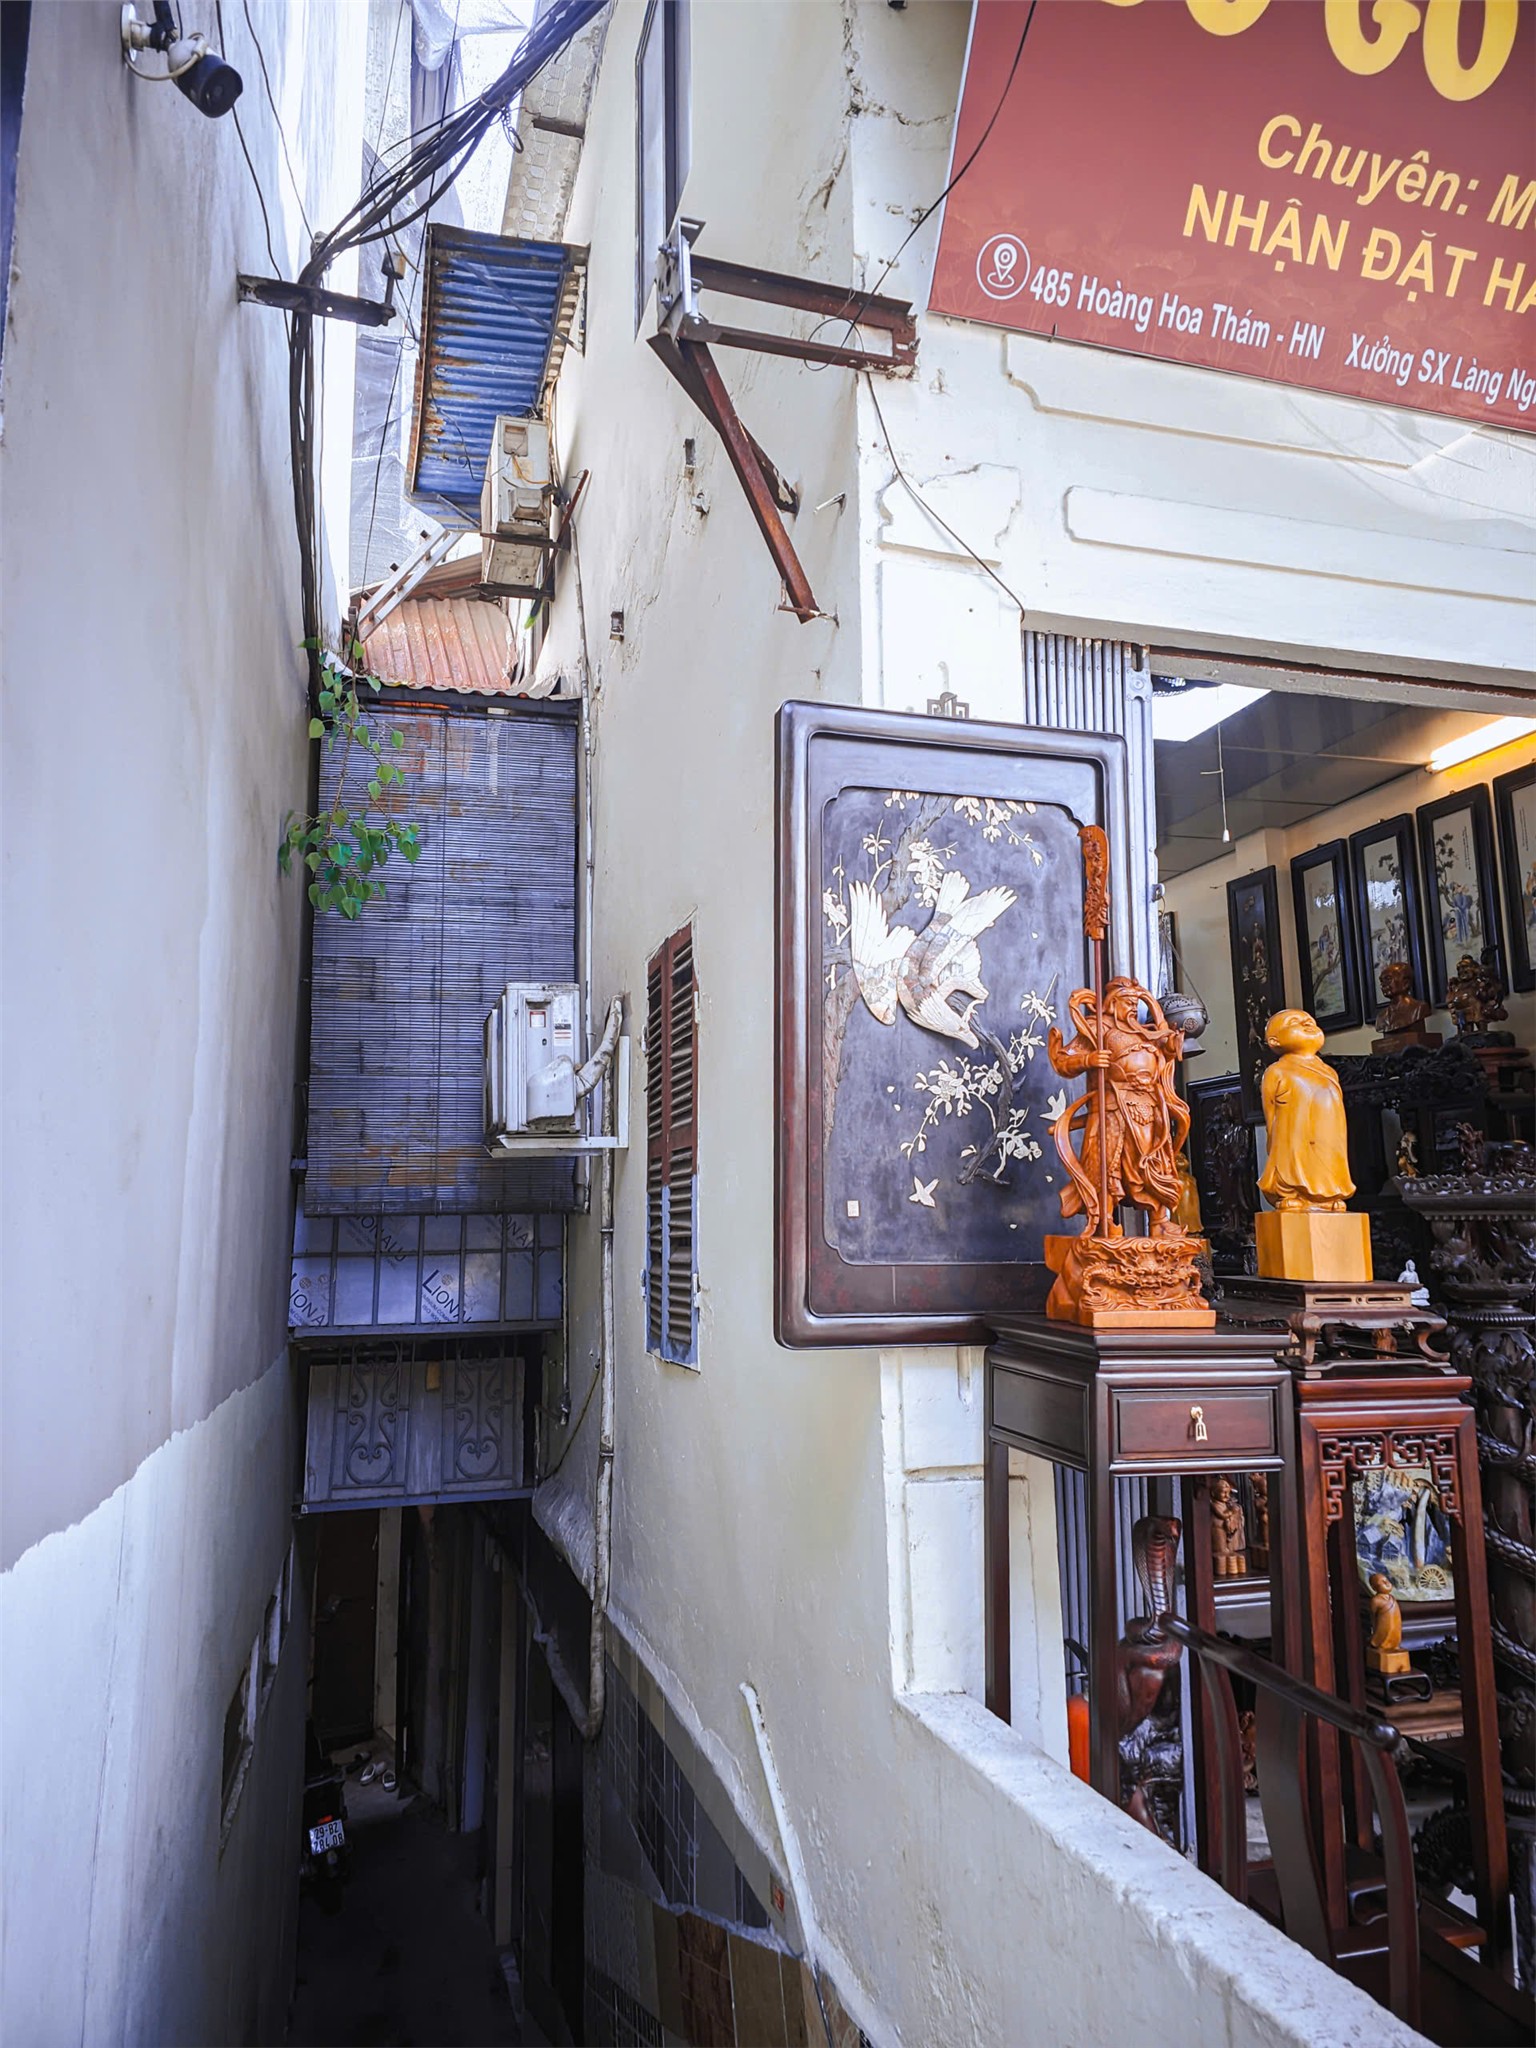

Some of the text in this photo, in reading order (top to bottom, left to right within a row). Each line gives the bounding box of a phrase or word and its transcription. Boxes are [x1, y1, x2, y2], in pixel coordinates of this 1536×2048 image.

[1258, 115, 1478, 216] Chuyên:
[1182, 183, 1350, 273] NHẬN
[1361, 226, 1478, 302] ĐẶT
[1030, 266, 1073, 308] 485
[1077, 275, 1154, 333] Hoàng
[1158, 292, 1203, 334] Hoa
[1211, 303, 1271, 348] Thám
[1288, 321, 1326, 359] HN
[1344, 333, 1414, 386] Xưởng
[1418, 349, 1451, 385] SX
[1451, 356, 1503, 405] Làng
